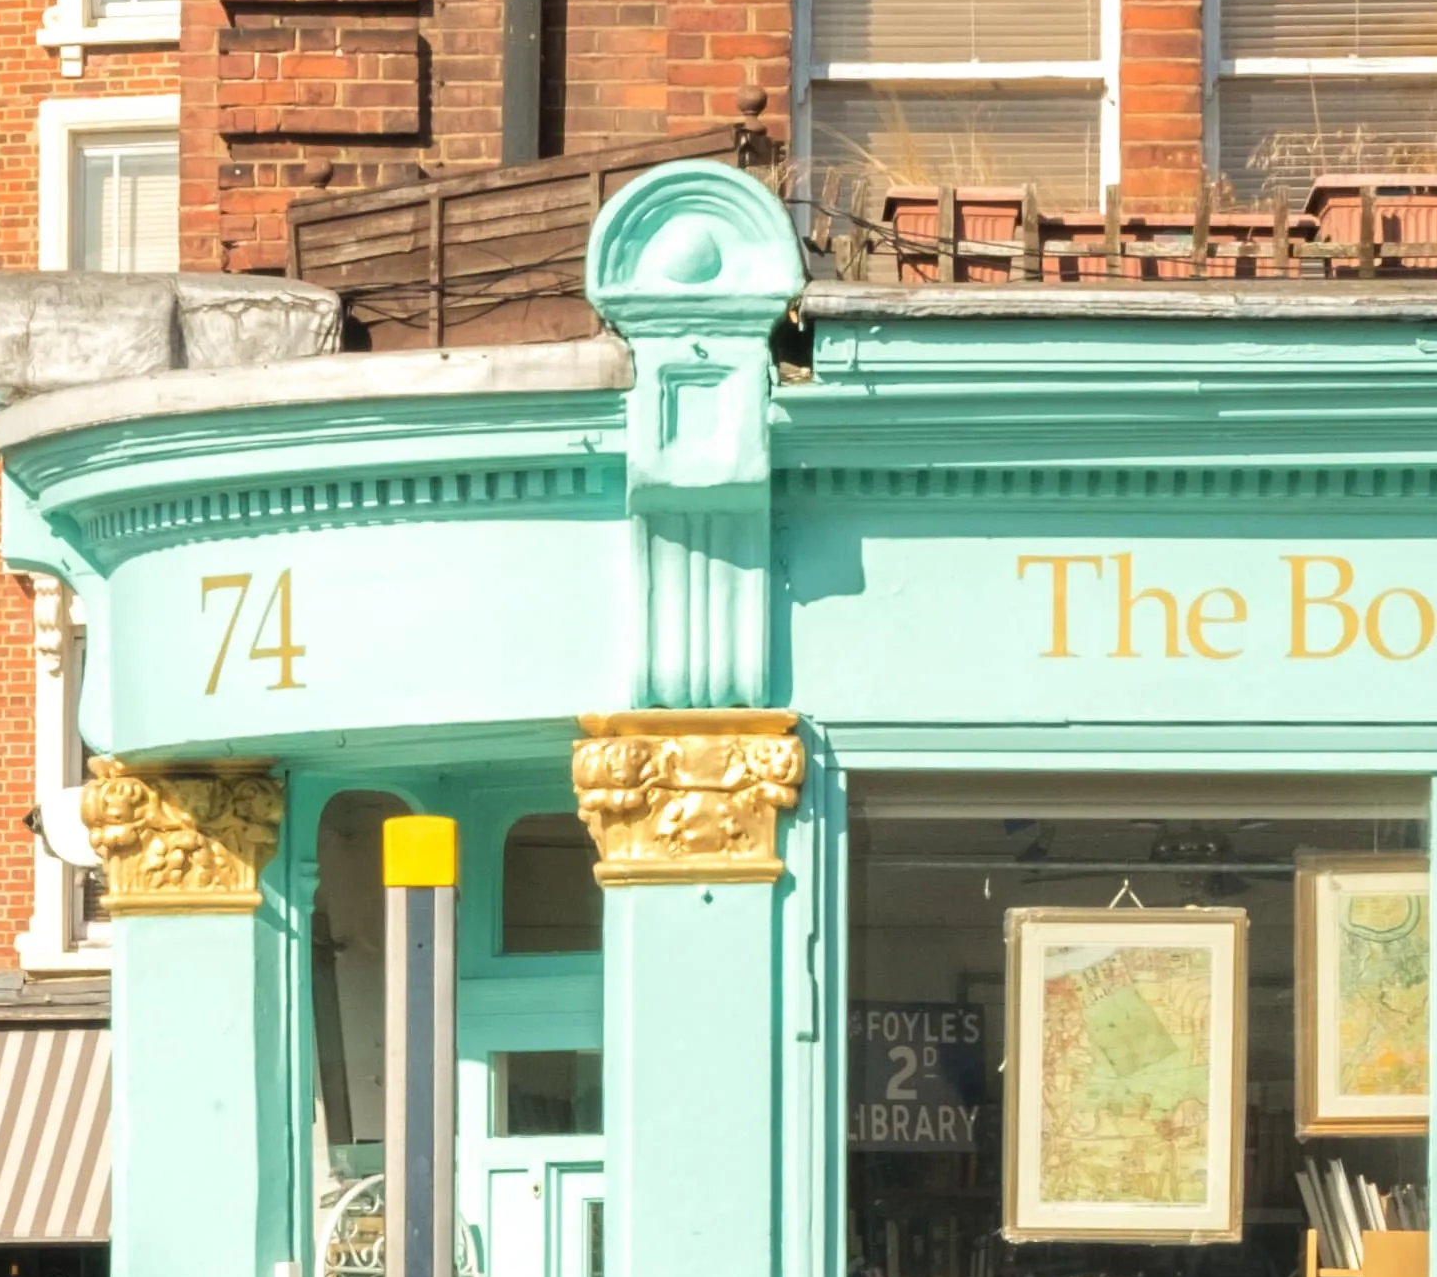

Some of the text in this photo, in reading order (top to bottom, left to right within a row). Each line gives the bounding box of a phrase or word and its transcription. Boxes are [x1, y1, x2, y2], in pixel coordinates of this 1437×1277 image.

[202, 567, 307, 695] 74
[1016, 551, 1248, 660] The
[867, 1008, 980, 1044] FOYLE'S
